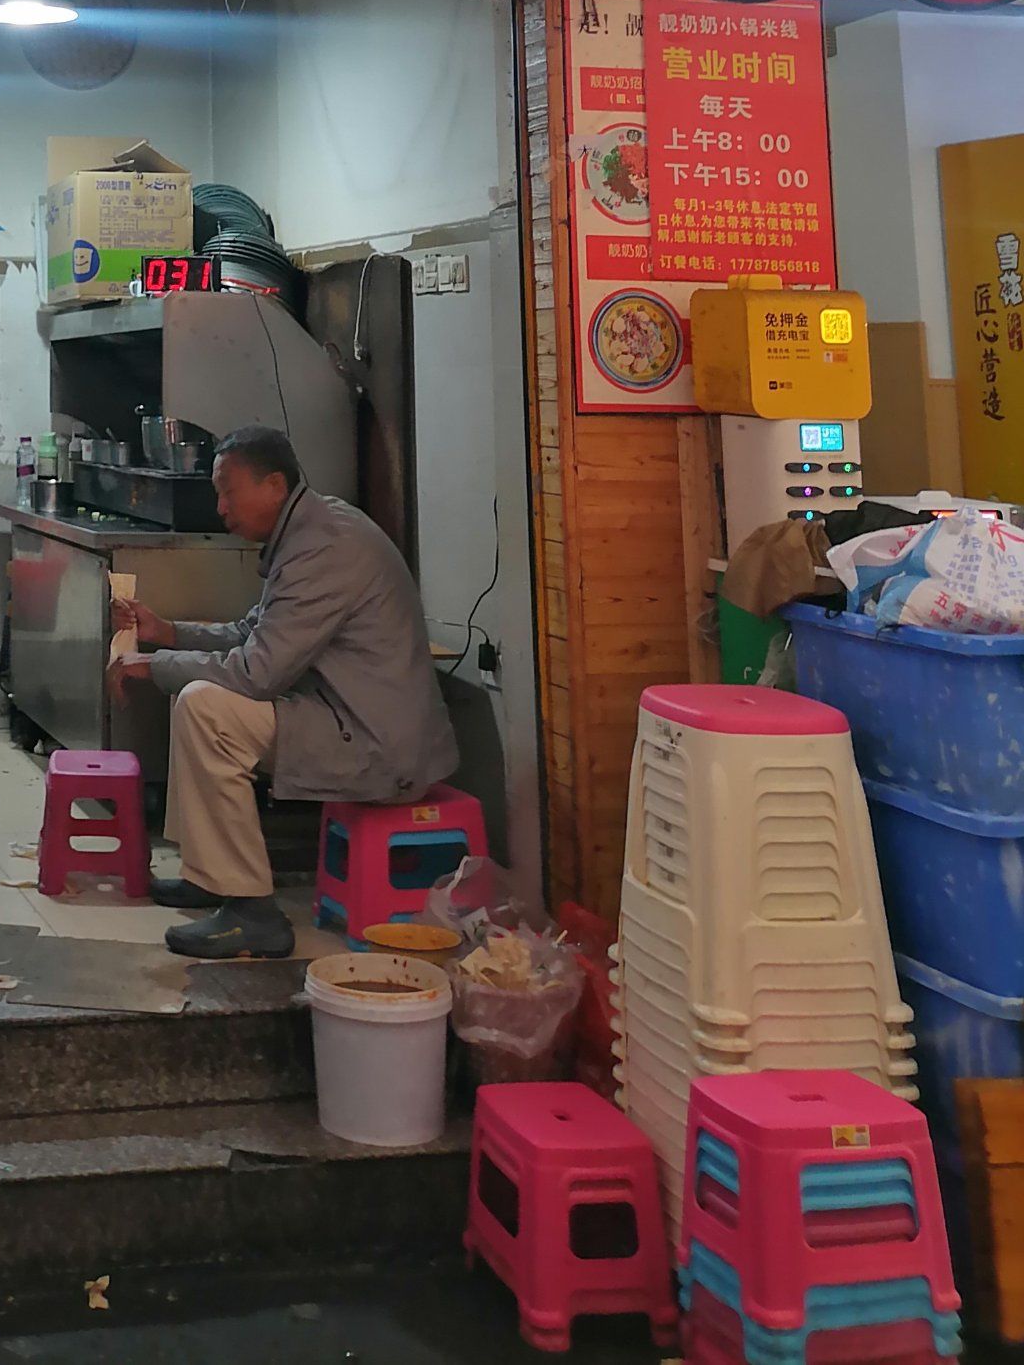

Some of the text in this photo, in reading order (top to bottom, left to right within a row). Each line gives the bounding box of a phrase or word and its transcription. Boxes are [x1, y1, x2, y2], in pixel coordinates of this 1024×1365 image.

[658, 12, 800, 39] 靓奶奶小锅米线
[662, 46, 797, 85] 营业时间
[699, 94, 753, 119] 每天
[147, 259, 212, 291] 031
[995, 233, 1024, 308] 雪花
[765, 312, 809, 328] 免押金
[765, 329, 810, 342] 借充电宝
[974, 283, 1006, 422] 匠心营造
